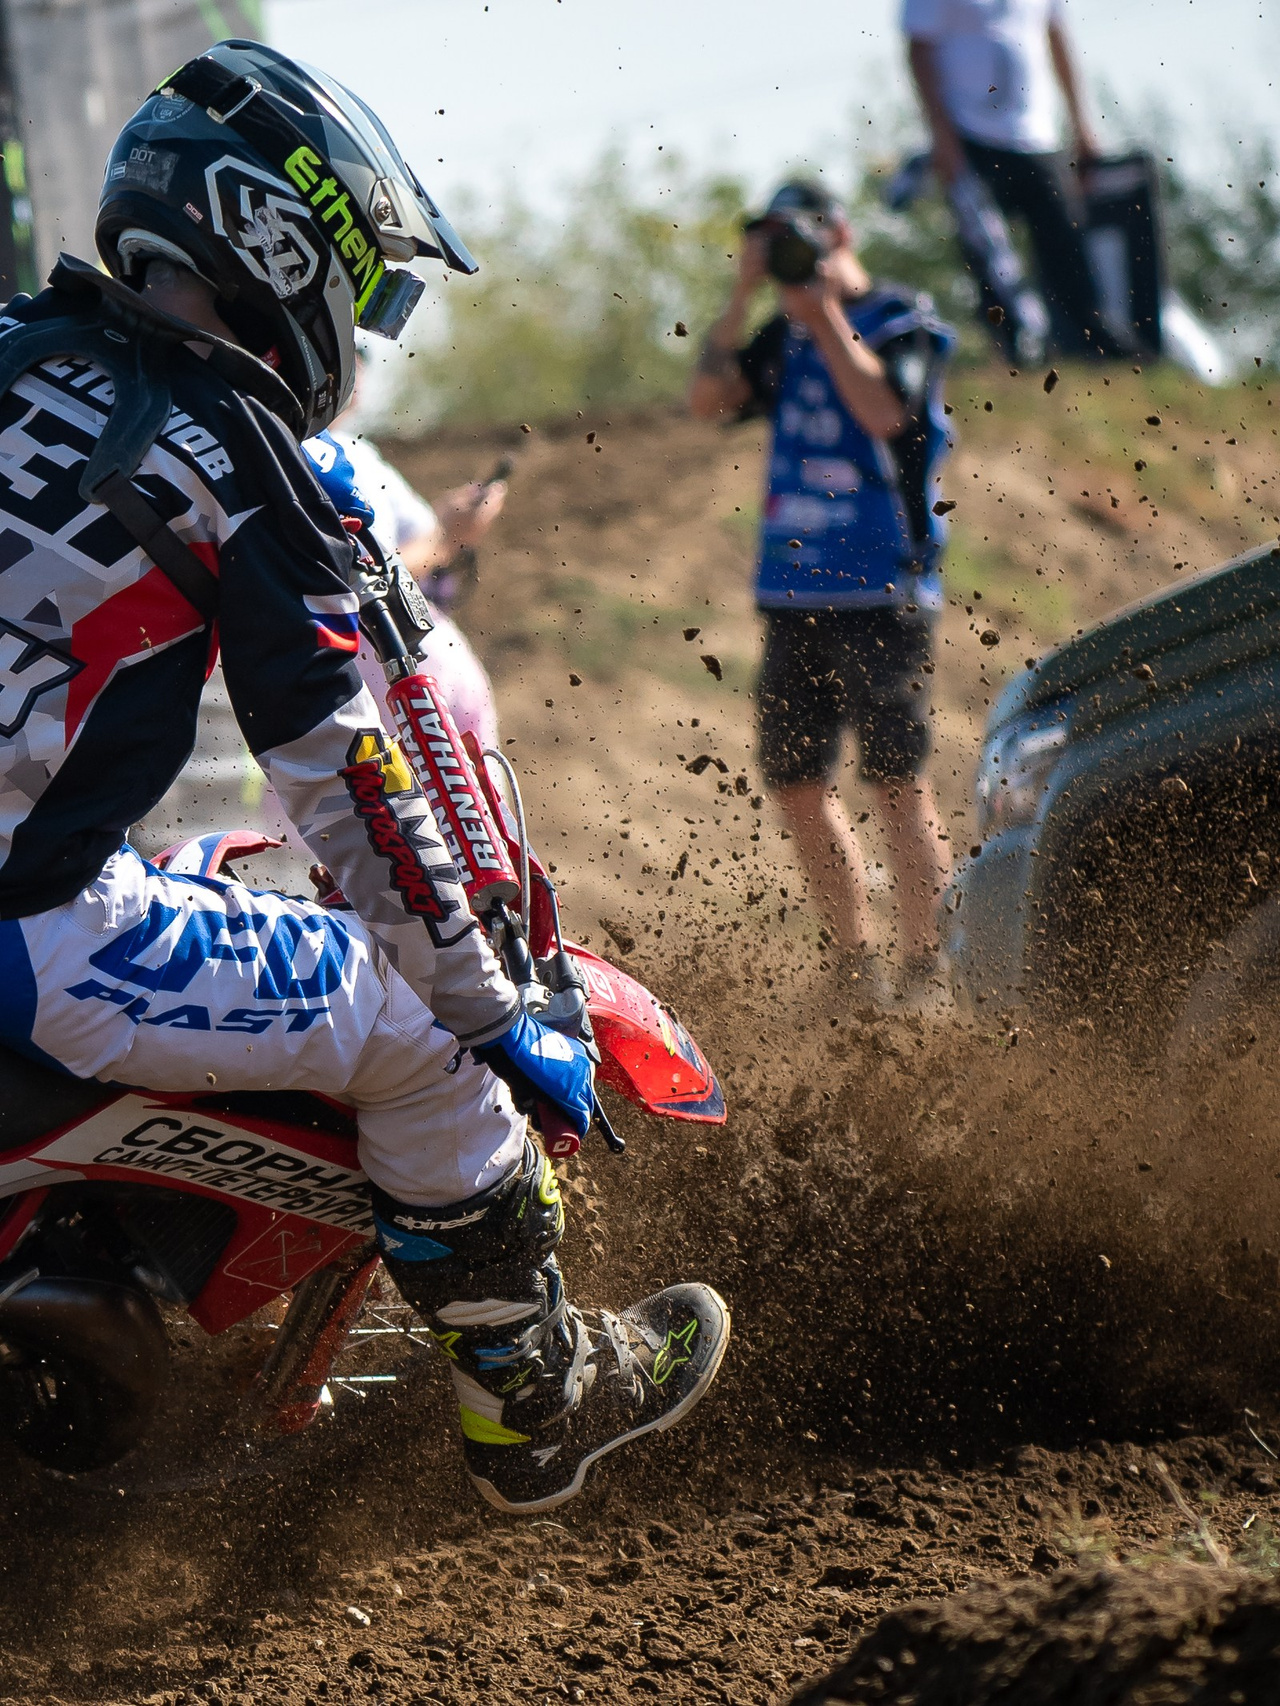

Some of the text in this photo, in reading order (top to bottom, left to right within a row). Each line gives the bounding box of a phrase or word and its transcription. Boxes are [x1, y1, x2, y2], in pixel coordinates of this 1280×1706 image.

[129, 147, 157, 163] DOT
[412, 686, 503, 870] RENTHAL
[339, 763, 443, 919] MOTOSPORT
[89, 900, 351, 1001] UFO
[63, 978, 331, 1034] PLAST
